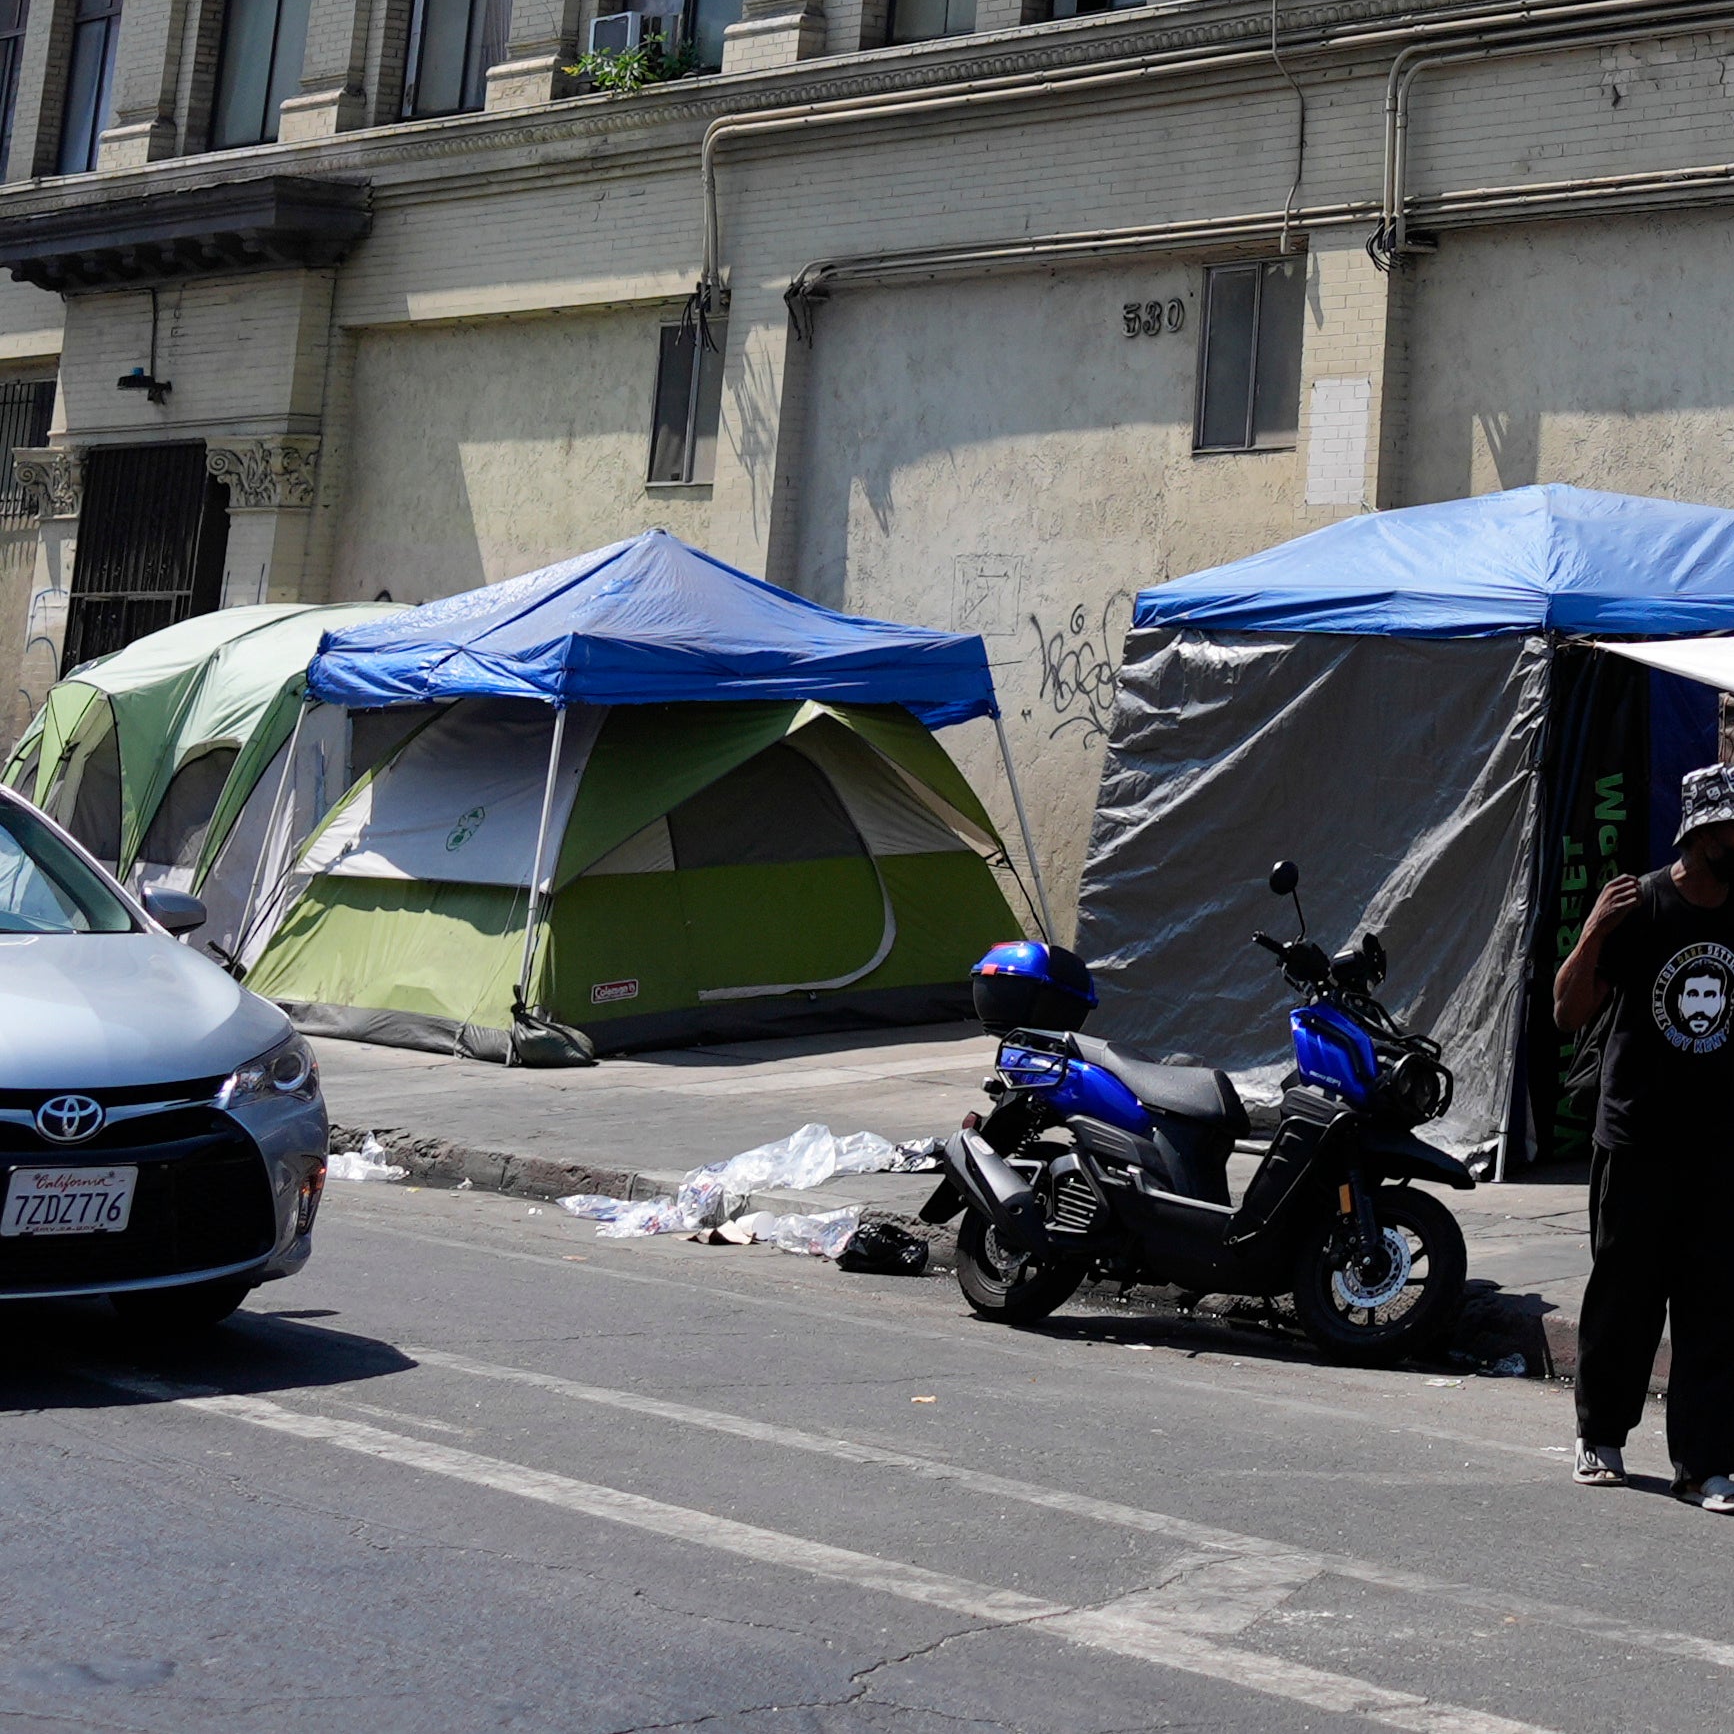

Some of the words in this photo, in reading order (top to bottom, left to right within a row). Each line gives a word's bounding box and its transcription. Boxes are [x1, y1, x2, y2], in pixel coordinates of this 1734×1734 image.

[1122, 297, 1185, 338] 530
[1657, 964, 1676, 986] YOU
[1676, 945, 1704, 965] DARE
[1663, 1024, 1694, 1052] ROY
[1693, 1027, 1728, 1054] KENT
[35, 1173, 112, 1193] California
[14, 1191, 126, 1226] 7ZDZ776
